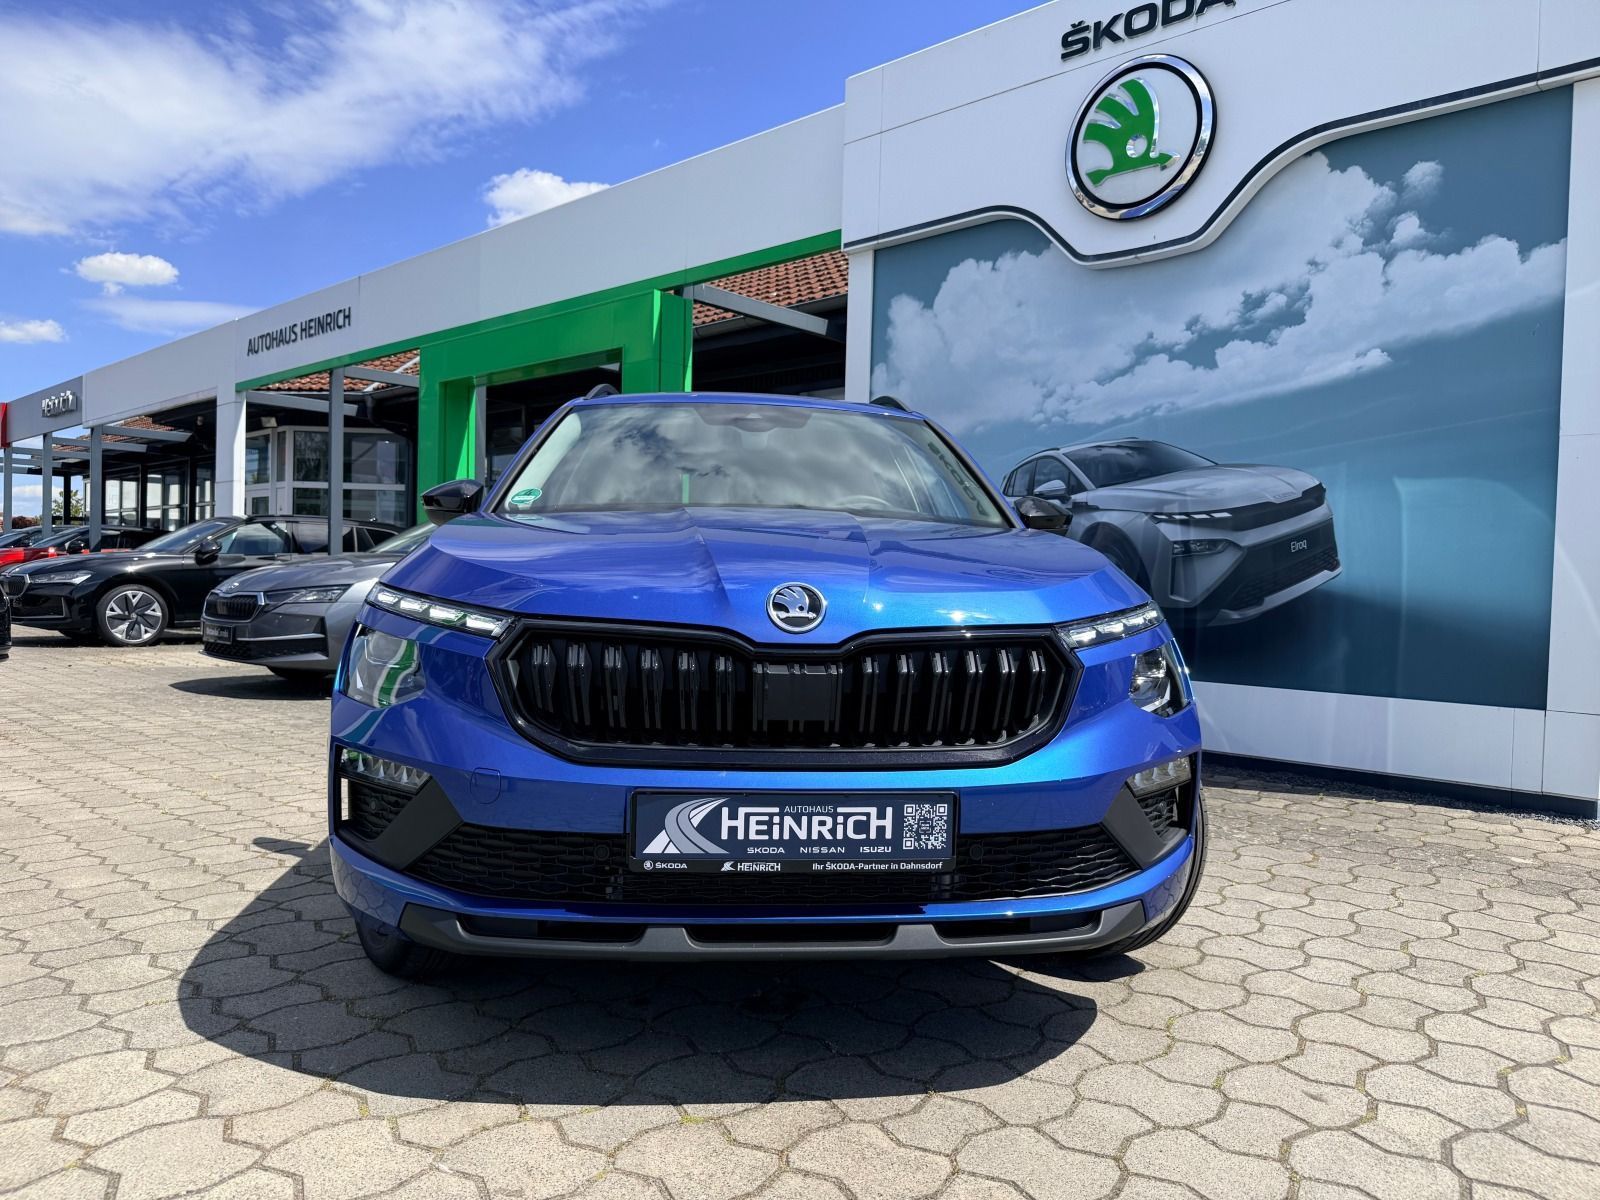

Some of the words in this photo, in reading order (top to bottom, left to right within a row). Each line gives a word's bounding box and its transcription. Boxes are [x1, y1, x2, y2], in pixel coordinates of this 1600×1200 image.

[247, 323, 298, 357] AUTOHAUS
[300, 306, 351, 340] HEINRICH
[1290, 540, 1307, 552] Elroq
[784, 805, 834, 813] AUTOHAUS
[800, 846, 845, 854] NISSAN
[825, 861, 889, 870] ŠKODA-Partner
[900, 861, 943, 869] Dahnsdorf
